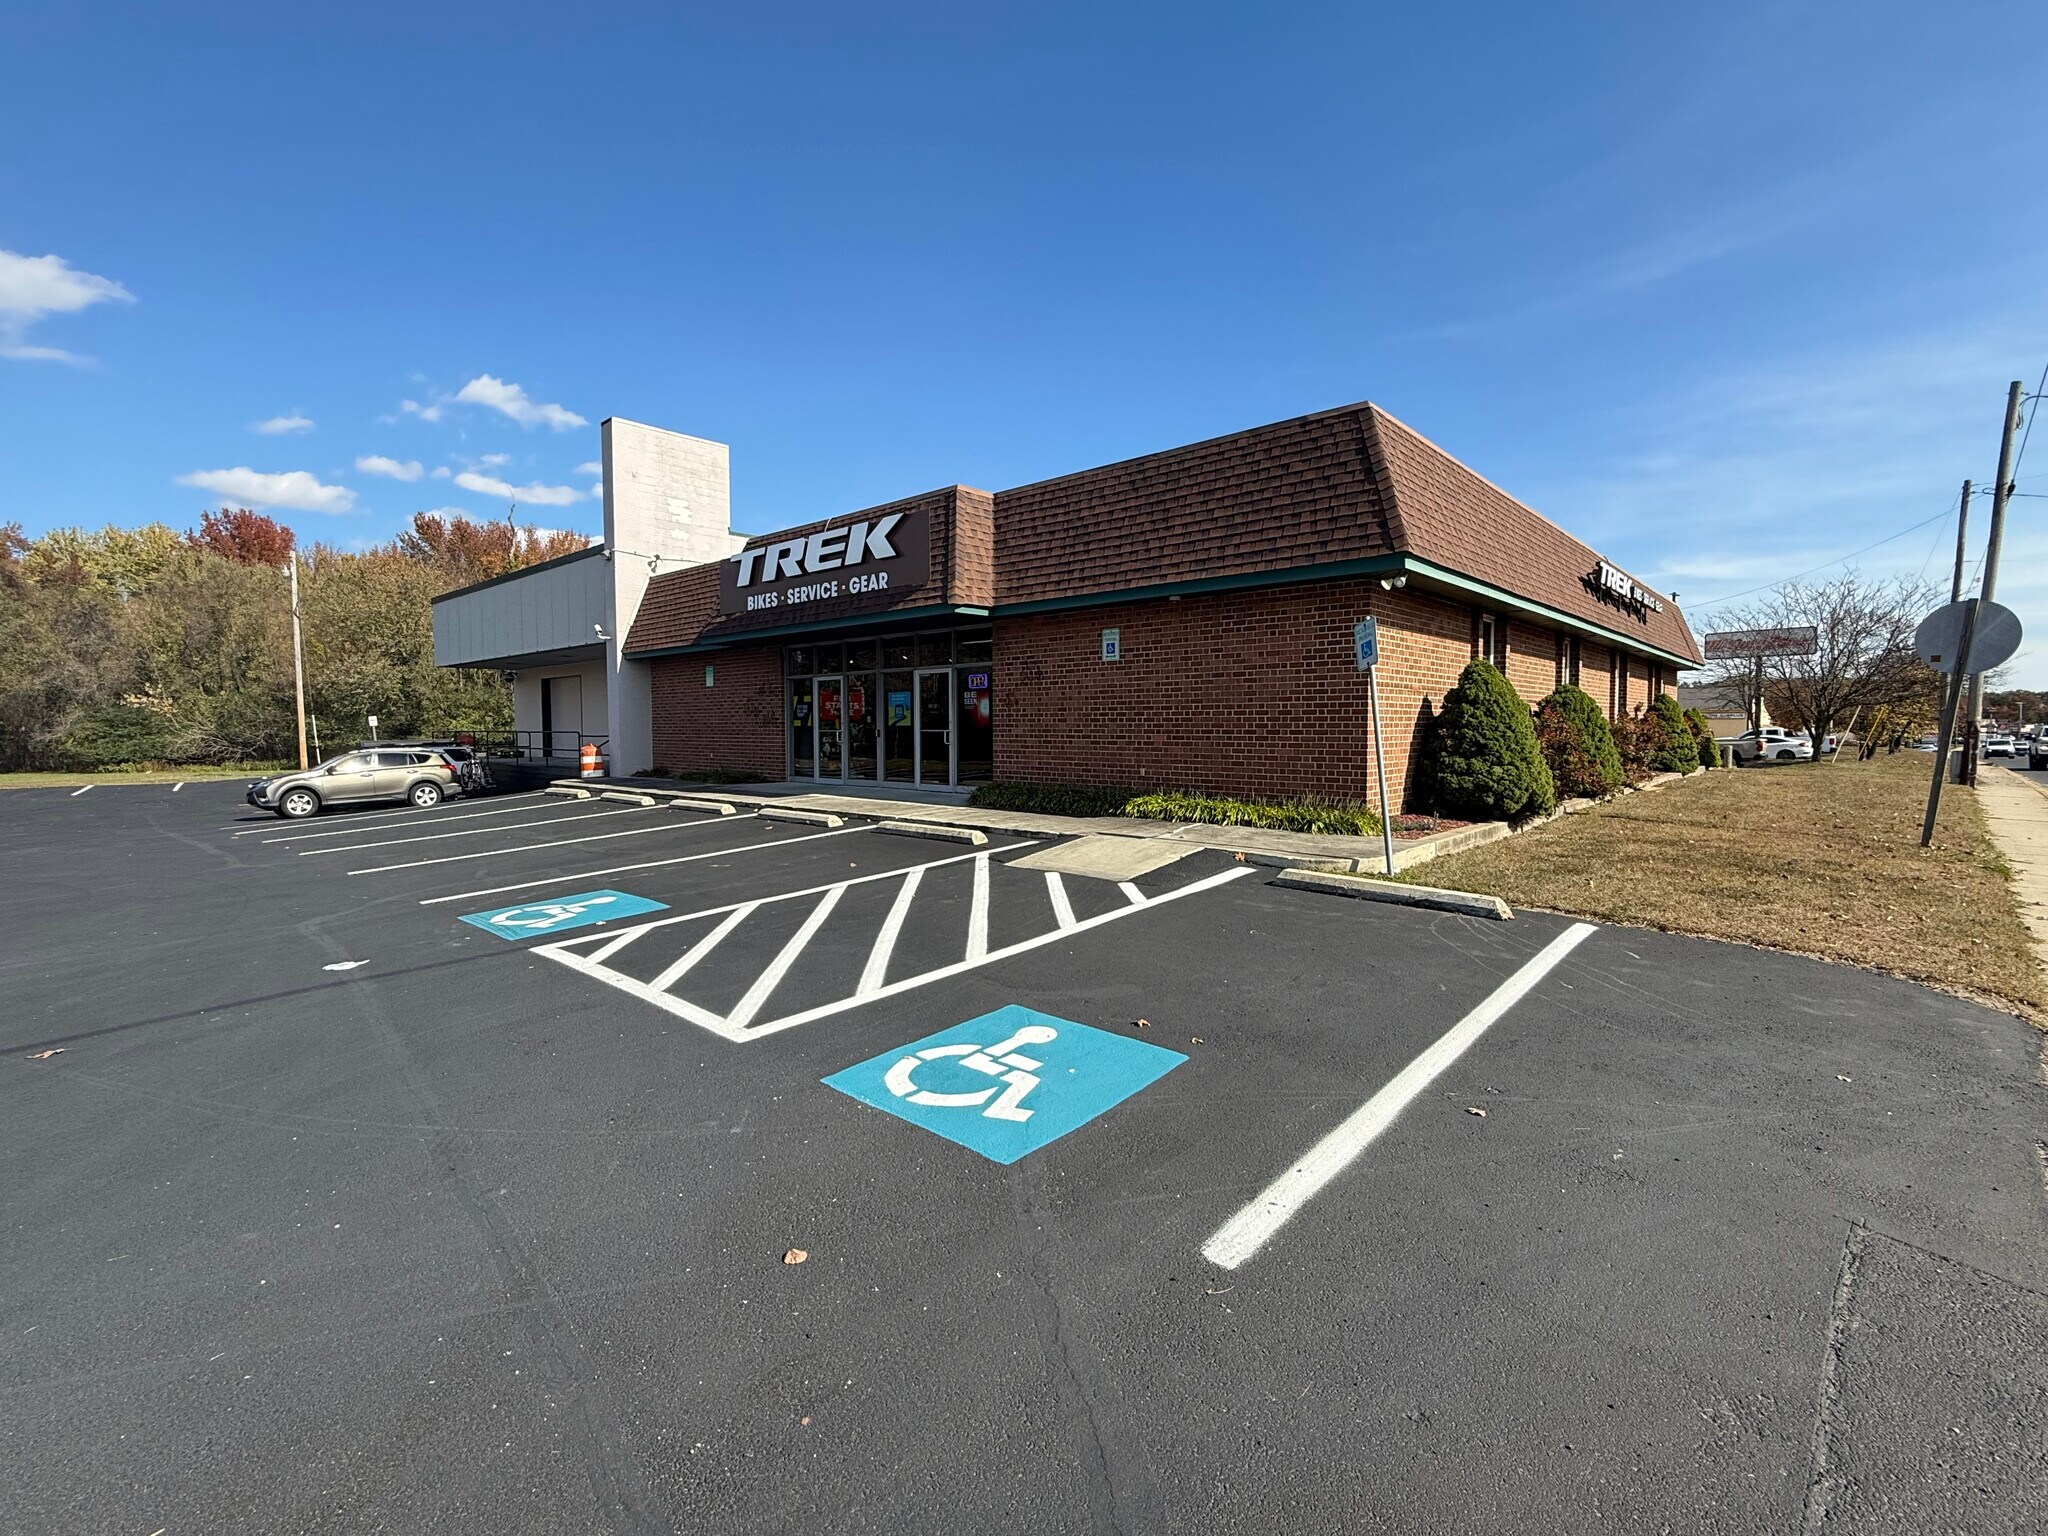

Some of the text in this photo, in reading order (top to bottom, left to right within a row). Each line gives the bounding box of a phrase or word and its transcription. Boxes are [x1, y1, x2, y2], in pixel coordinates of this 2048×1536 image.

[730, 512, 905, 588] TREK
[747, 572, 888, 611] BIKES SERVICE GEAR
[1599, 561, 1633, 599] TREK
[825, 701, 860, 710] STATS
